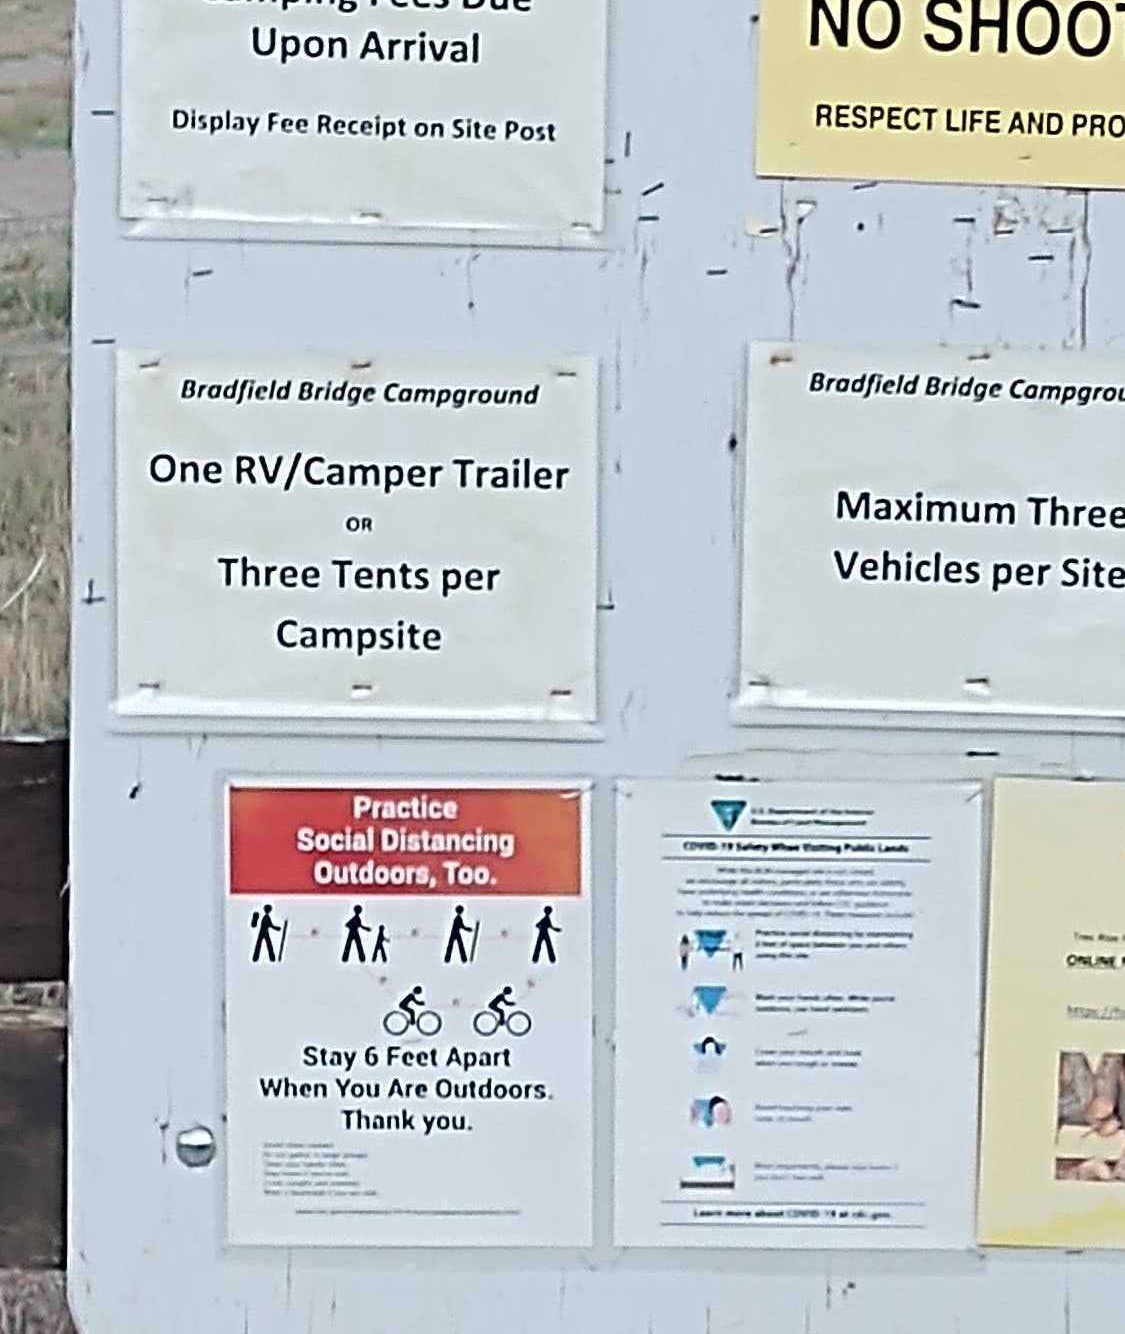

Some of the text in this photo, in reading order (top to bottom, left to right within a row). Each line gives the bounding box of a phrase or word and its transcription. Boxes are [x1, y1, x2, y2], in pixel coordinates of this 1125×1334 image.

[251, 27, 481, 64] Upon Arrival
[172, 110, 558, 143] Display Fee Receipt on Site Post
[815, 104, 938, 132] RESPECT
[945, 110, 1001, 134] LIFE
[1008, 113, 1064, 136] AND
[180, 379, 539, 408] Bradfield Bridge Campground
[809, 372, 918, 398] Bradfield
[924, 377, 1003, 403] Bridge
[149, 453, 570, 494] One RV/Camper Trailer
[836, 491, 1016, 526] Maximum
[345, 516, 373, 532] OR
[217, 557, 500, 597] Three Tents per
[833, 550, 980, 585] Vehicles
[991, 560, 1051, 592] per
[276, 619, 442, 655] Campsite
[353, 796, 458, 820] Practice
[297, 828, 515, 857] Social Distancing
[314, 861, 497, 887] Outdoors, Too.
[1067, 954, 1115, 967] ONLINE
[303, 1046, 512, 1071] Stay 6 Feet Apart
[259, 1079, 554, 1100] When You Are Outdoors.
[341, 1111, 473, 1137] Thank you.
